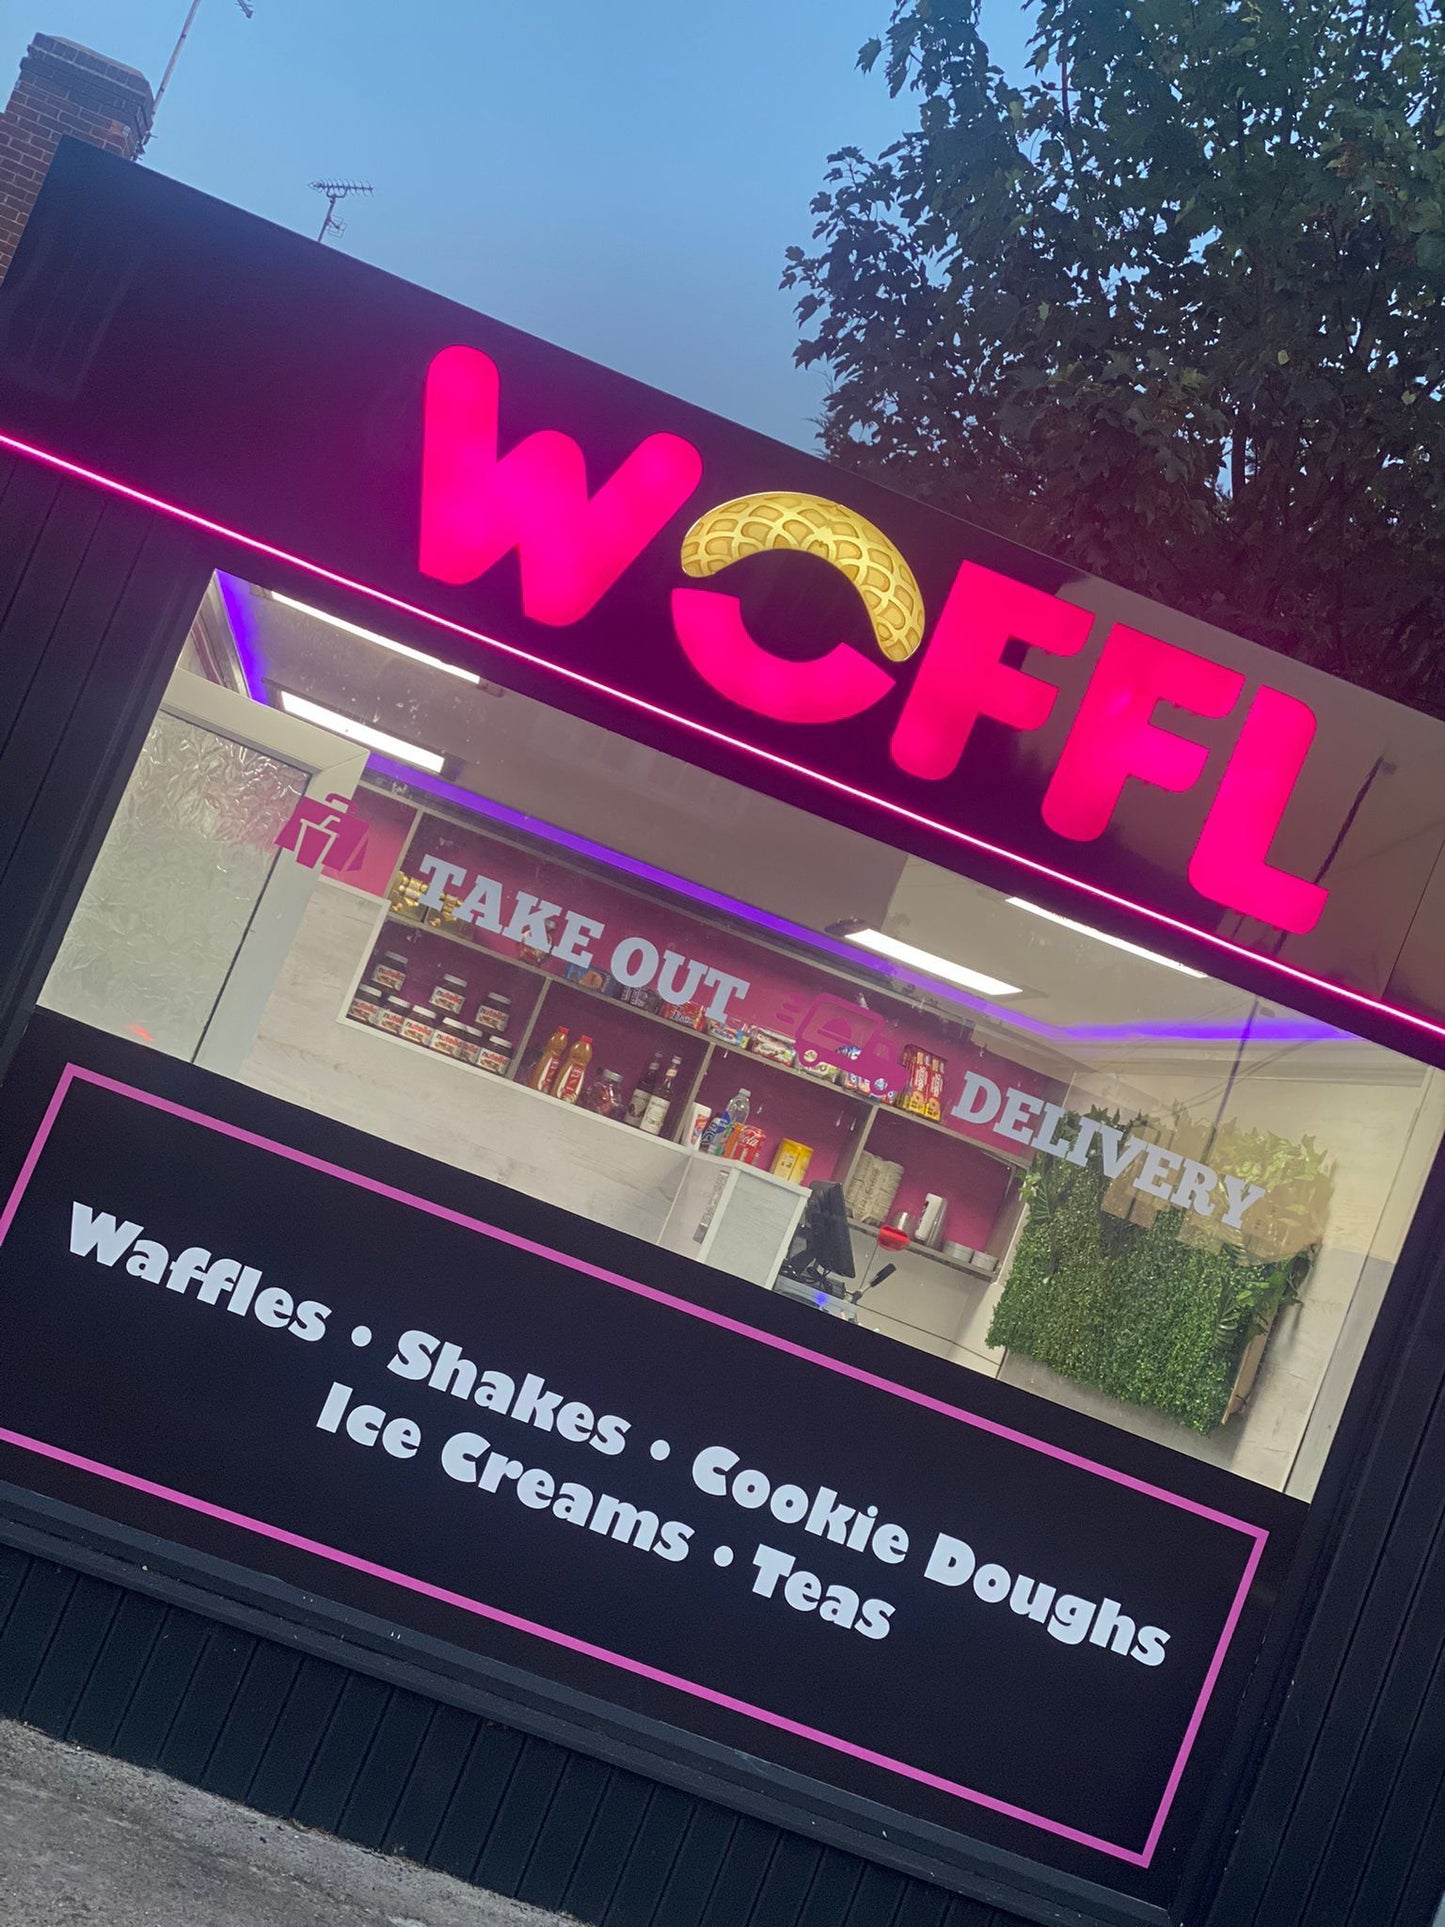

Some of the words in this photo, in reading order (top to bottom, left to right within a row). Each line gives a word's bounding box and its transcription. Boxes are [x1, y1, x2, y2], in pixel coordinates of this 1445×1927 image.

[418, 344, 1329, 935] WOFFL
[417, 853, 606, 969] TAKE
[610, 936, 751, 1024] OUT
[951, 1070, 1267, 1230] DELIVERY
[69, 1201, 333, 1343] Waffles
[386, 1329, 632, 1456] Shakes
[692, 1445, 909, 1564] Cookie
[923, 1532, 1171, 1666] Doughs
[316, 1381, 422, 1459] Ice
[441, 1432, 695, 1564] Creams
[752, 1543, 896, 1640] Teas
